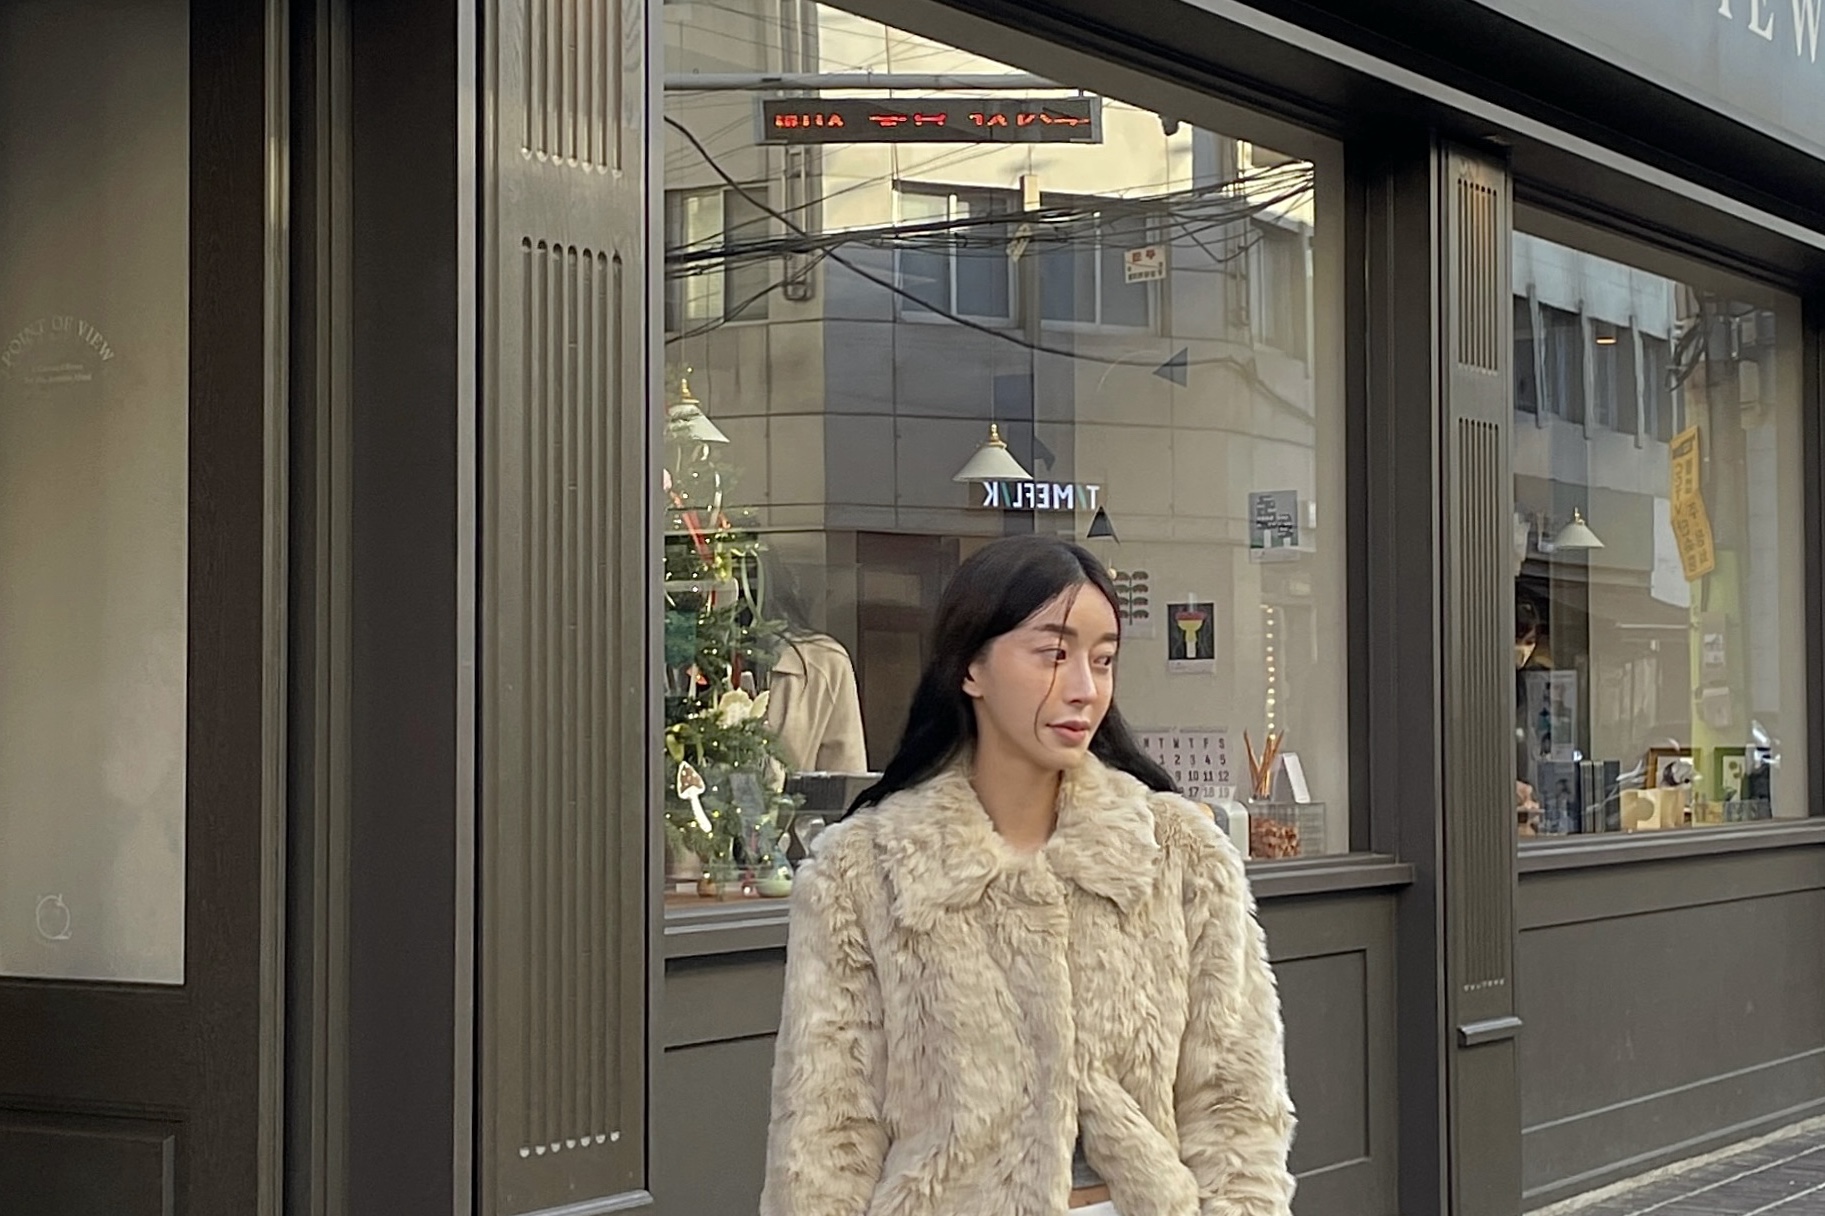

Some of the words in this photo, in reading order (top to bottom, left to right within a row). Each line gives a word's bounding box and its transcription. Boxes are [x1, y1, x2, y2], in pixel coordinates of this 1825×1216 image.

[2, 318, 46, 367] POINT
[51, 315, 74, 332] OF
[78, 319, 115, 361] VIEW
[1159, 737, 1164, 749] T
[1173, 737, 1180, 749] W
[1189, 737, 1194, 749] T
[1203, 737, 1209, 749] F
[1219, 737, 1225, 749] S
[1159, 754, 1165, 765] 1
[1174, 754, 1180, 765] 2
[1190, 754, 1196, 766] 3
[1205, 754, 1211, 765] 4
[1220, 754, 1226, 765] 5
[1188, 770, 1199, 781] 10
[1203, 770, 1213, 782] 11
[1218, 770, 1229, 782] 12
[1188, 786, 1199, 797] 17
[1203, 786, 1215, 798] 18
